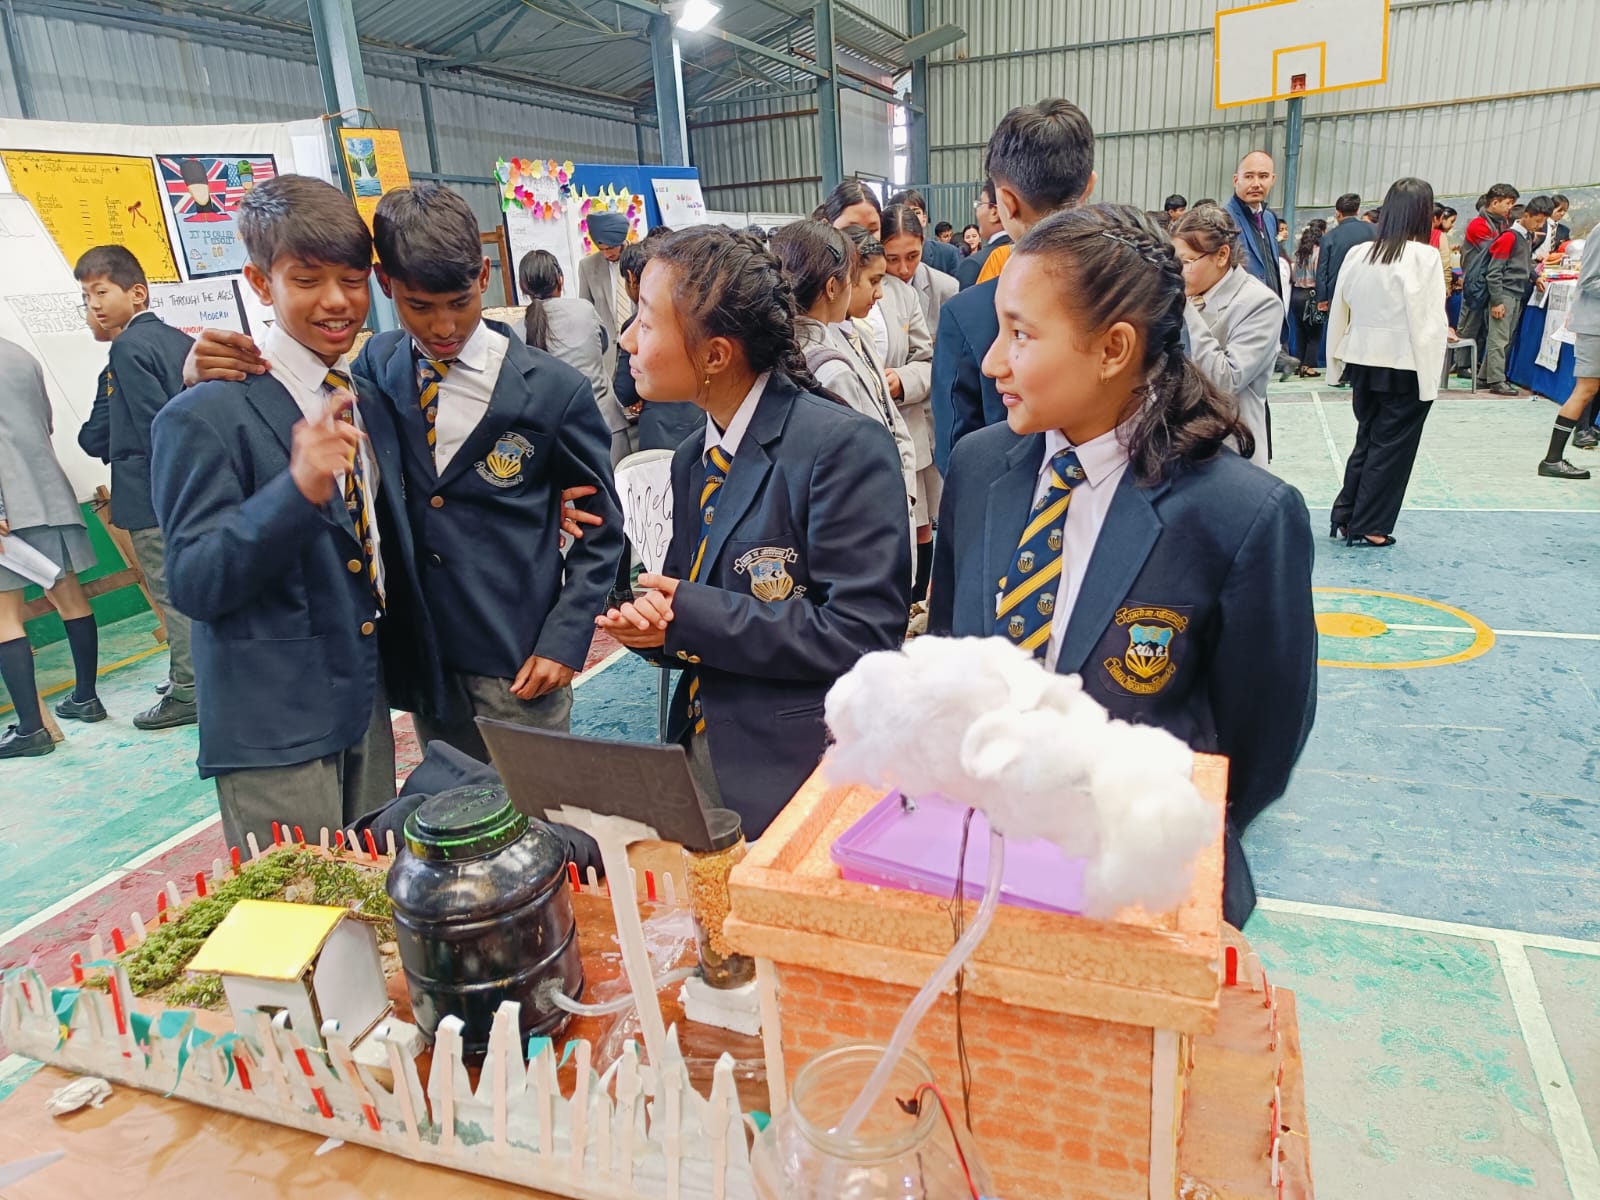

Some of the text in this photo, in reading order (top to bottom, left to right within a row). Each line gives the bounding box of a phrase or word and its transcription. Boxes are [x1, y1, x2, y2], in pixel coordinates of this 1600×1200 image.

[169, 294, 200, 306] THROUGH
[201, 291, 214, 302] THE
[217, 289, 234, 302] AGES
